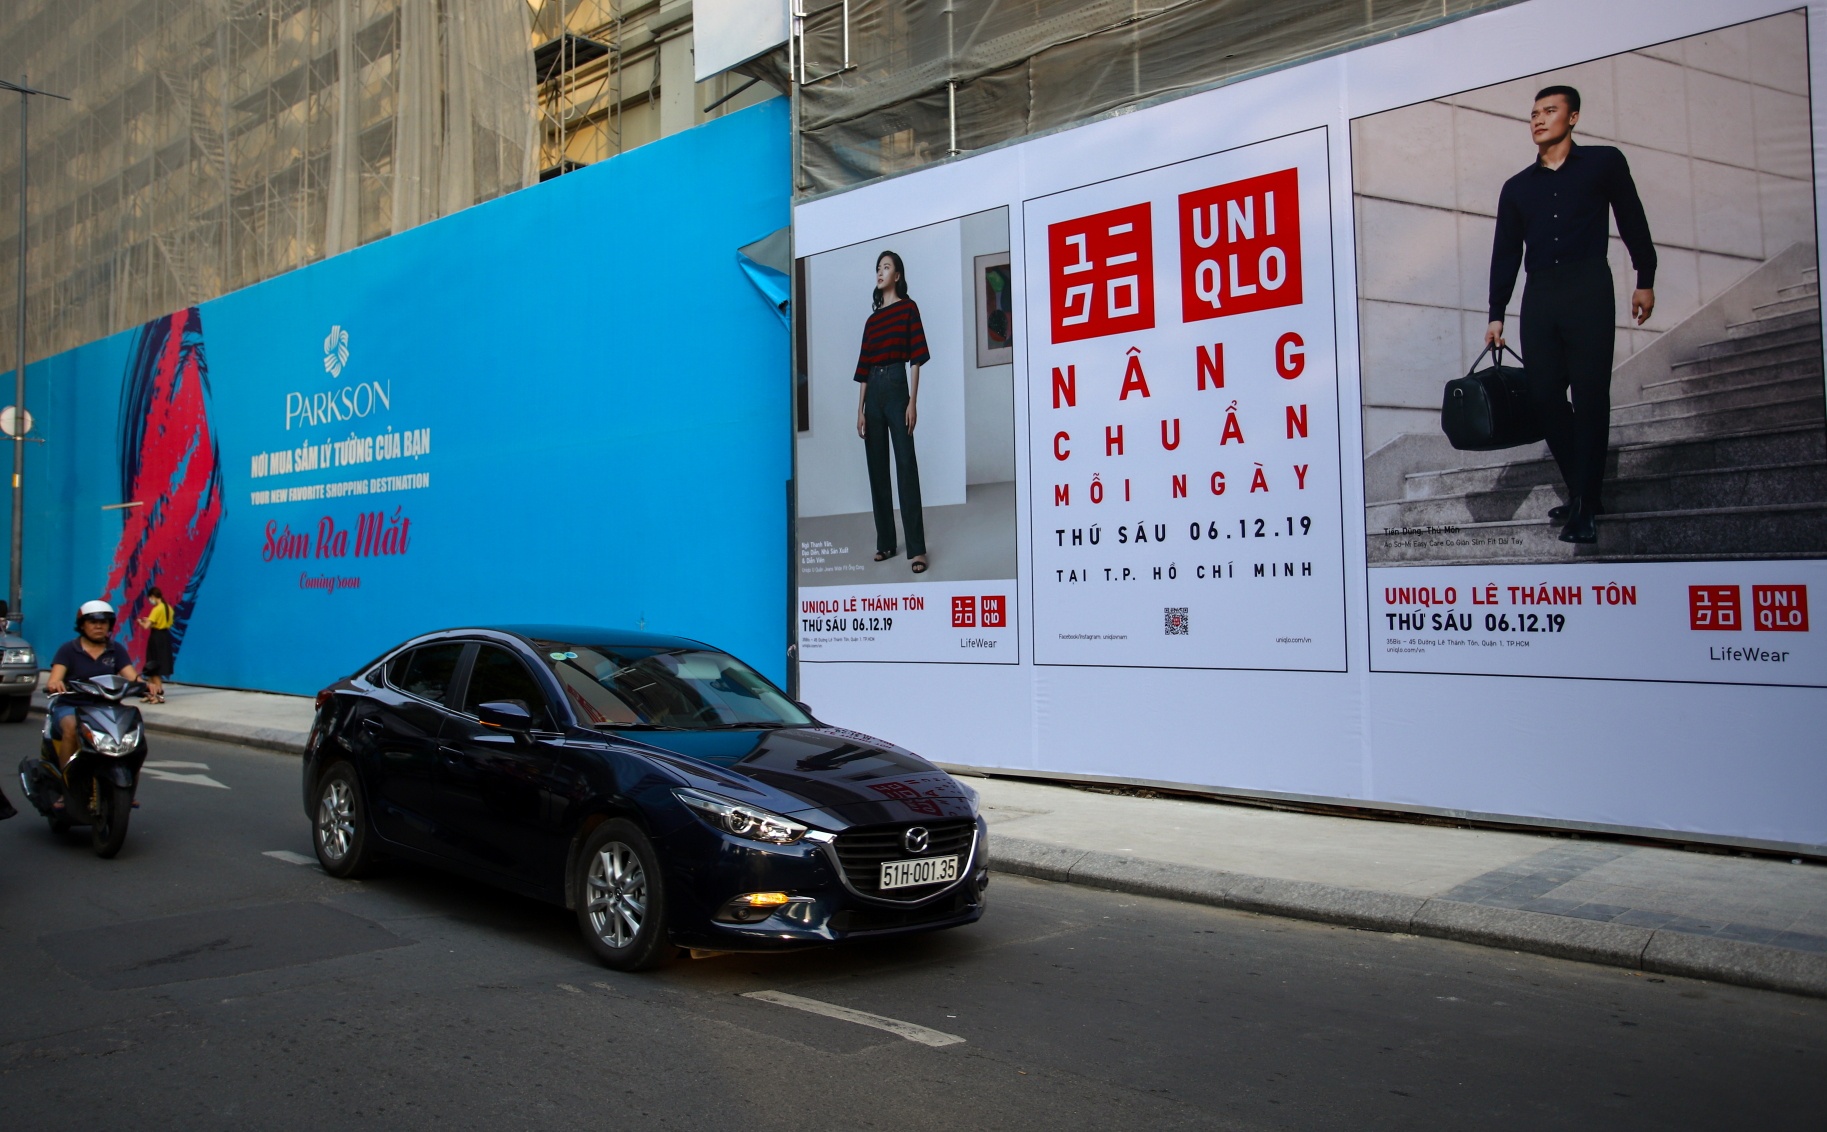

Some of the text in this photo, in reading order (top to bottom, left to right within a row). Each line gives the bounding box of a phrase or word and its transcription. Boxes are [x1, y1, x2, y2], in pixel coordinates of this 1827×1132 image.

[1192, 190, 1276, 248] UNI
[1195, 246, 1287, 309] QLO
[251, 425, 431, 479] NƠI MUA SẮM LÝ TƯỞNG CỦA BẠN
[250, 471, 430, 506] YOUR NEW FAVORITE SHOPPING DESTINATION
[1054, 461, 1309, 507] MỖI NGÀY
[261, 504, 413, 563] Sớm Ra Mắt
[1055, 516, 1312, 547] THỨ SÁU 06.12.19
[299, 571, 361, 594] Coming soon
[1056, 561, 1313, 585] TẠI T.P. HỒ CHÍ MINH
[802, 593, 924, 615] UNIQLO LÊ THÁNH TÔN
[1385, 581, 1637, 608] UNIQLO LÊ THÁNH TÔN
[1758, 590, 1797, 607] UNI
[802, 615, 893, 632] THỨ SÁU 06.12.19
[1386, 608, 1566, 633] THỨ SÁU 06.12.19
[1759, 609, 1802, 629] QLO
[960, 638, 998, 648] LifeWear
[1710, 646, 1790, 662] LifeWear
[883, 858, 956, 886] 51H-001.35
